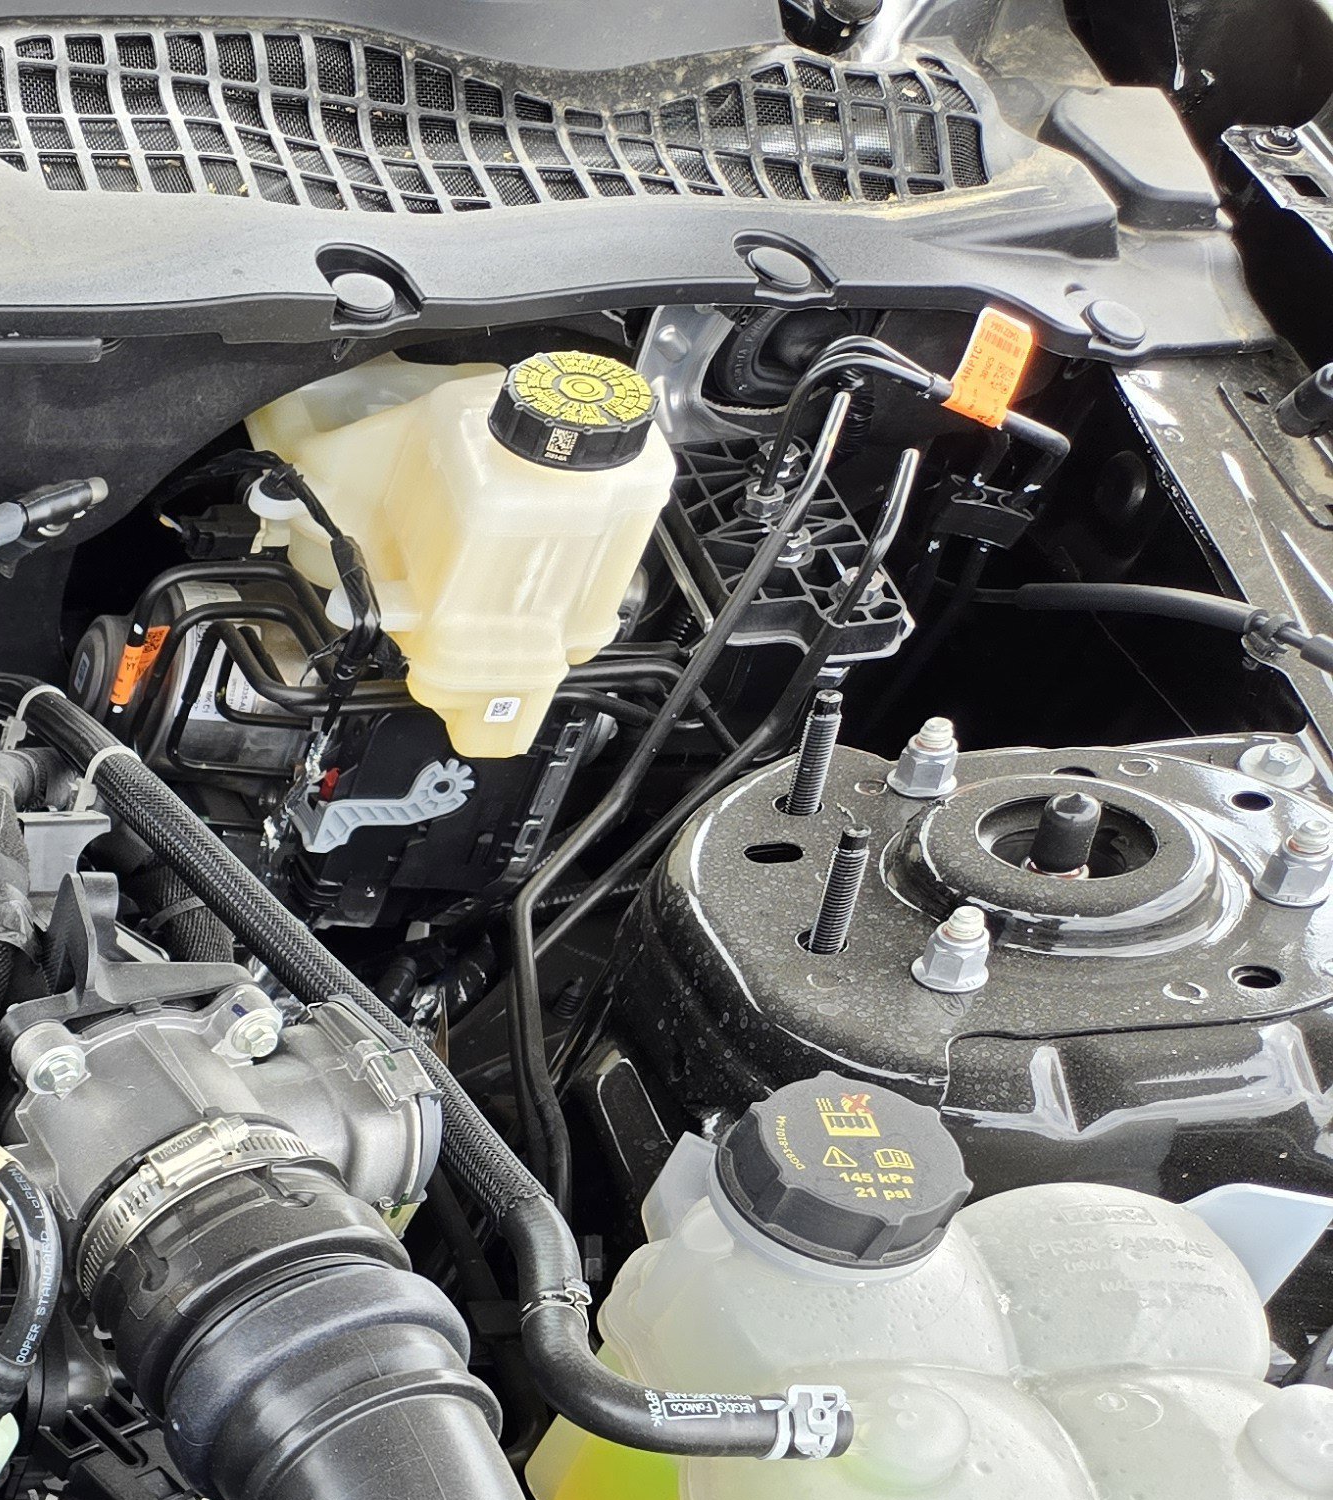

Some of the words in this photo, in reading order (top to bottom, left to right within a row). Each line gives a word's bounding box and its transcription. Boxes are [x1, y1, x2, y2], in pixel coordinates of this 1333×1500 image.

[839, 1172, 874, 1184] 145
[877, 1173, 915, 1185] kPa
[854, 1187, 877, 1198] 21
[883, 1187, 912, 1201] psi
[15, 1323, 41, 1364] OOPER
[36, 1230, 56, 1317] STANDARD
[670, 1402, 714, 1414] FoMoCo
